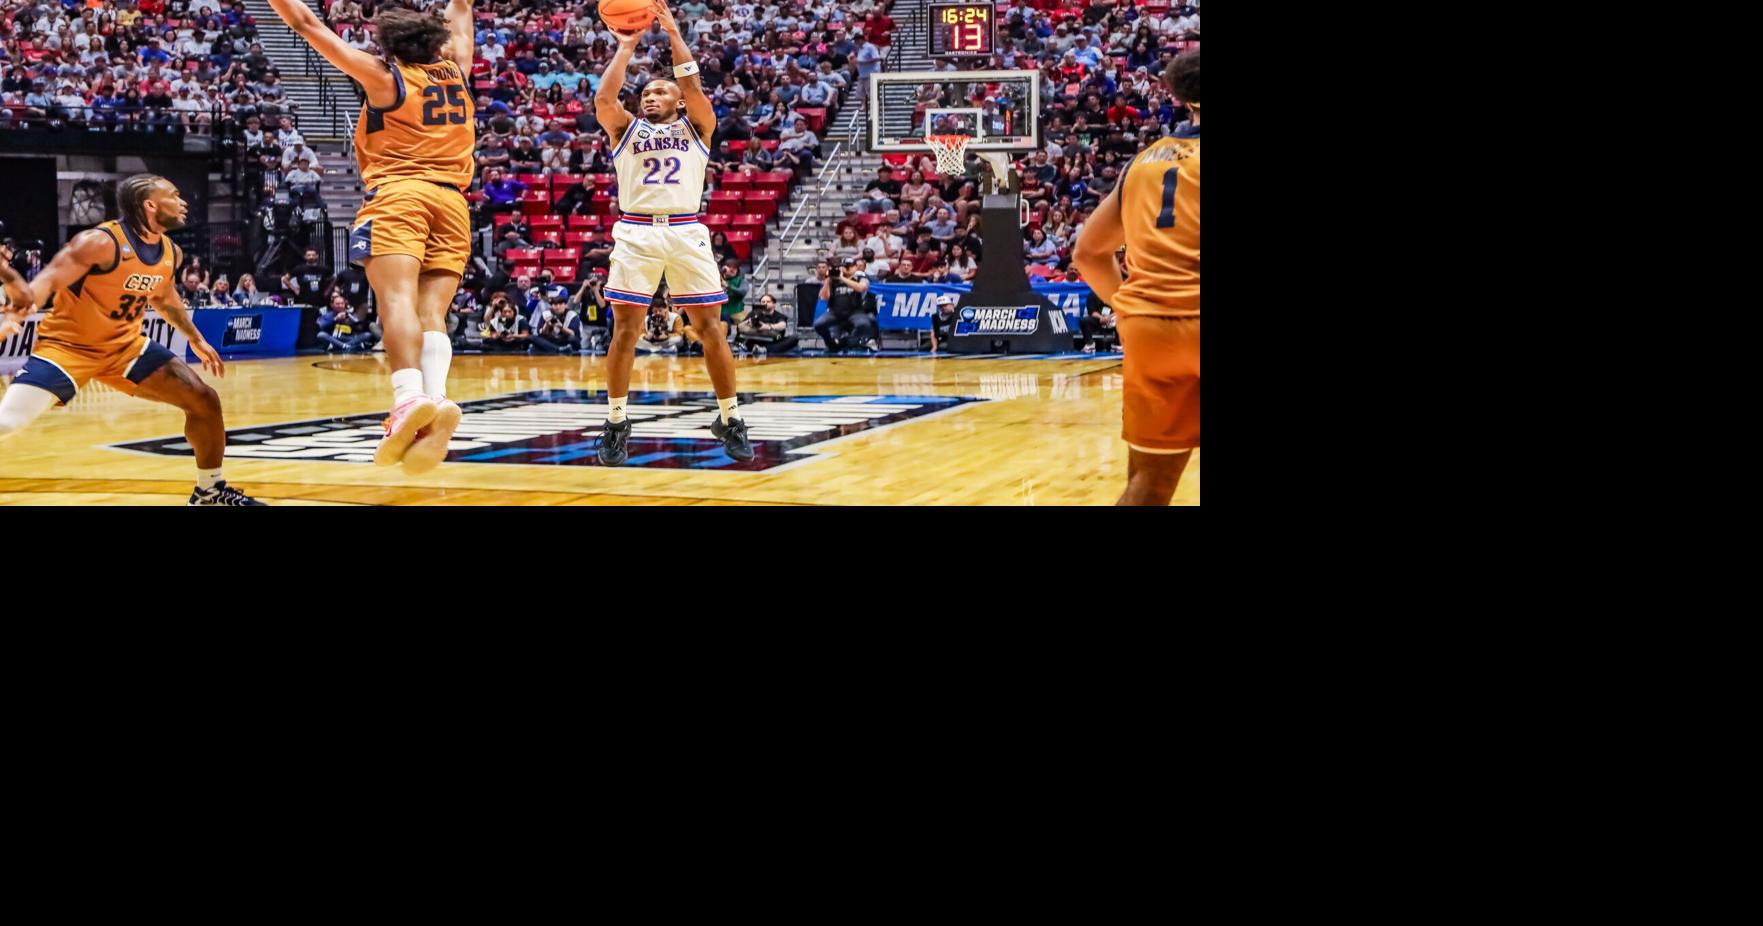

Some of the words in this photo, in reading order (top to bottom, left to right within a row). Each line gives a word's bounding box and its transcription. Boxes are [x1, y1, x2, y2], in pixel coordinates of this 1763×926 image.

[942, 8, 987, 24] 16:24
[954, 24, 981, 50] 13
[423, 85, 467, 125] 25
[632, 137, 690, 155] KANSAS
[643, 156, 682, 186] 22
[1155, 167, 1179, 229] 1
[233, 317, 253, 329] MARCH
[974, 309, 1017, 320] MARCH
[979, 319, 1037, 331] MADNESS
[235, 329, 261, 341] MADNESS
